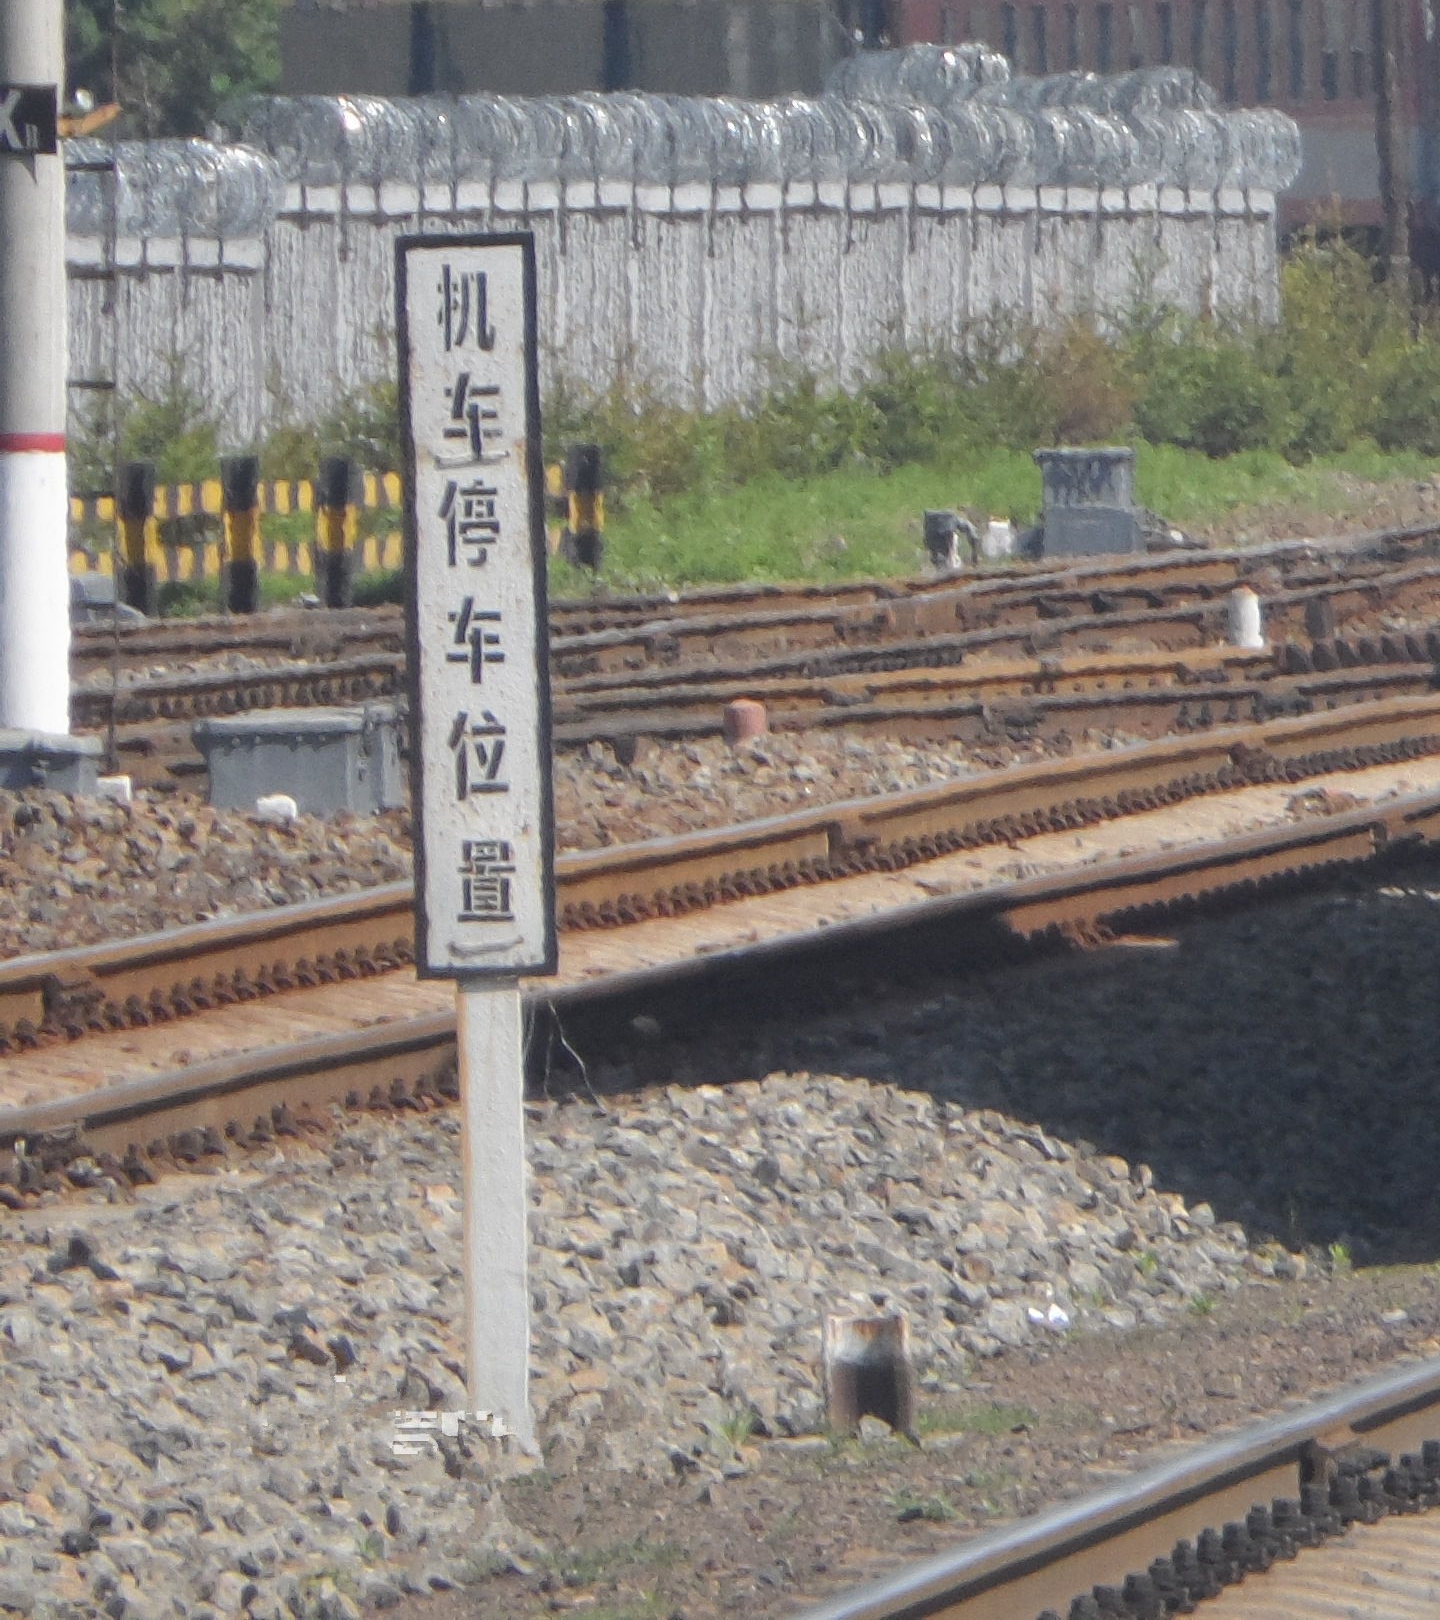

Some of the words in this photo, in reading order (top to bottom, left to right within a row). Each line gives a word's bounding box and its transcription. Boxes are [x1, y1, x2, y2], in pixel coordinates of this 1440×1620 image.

[435, 263, 517, 924] 机车停车位置
